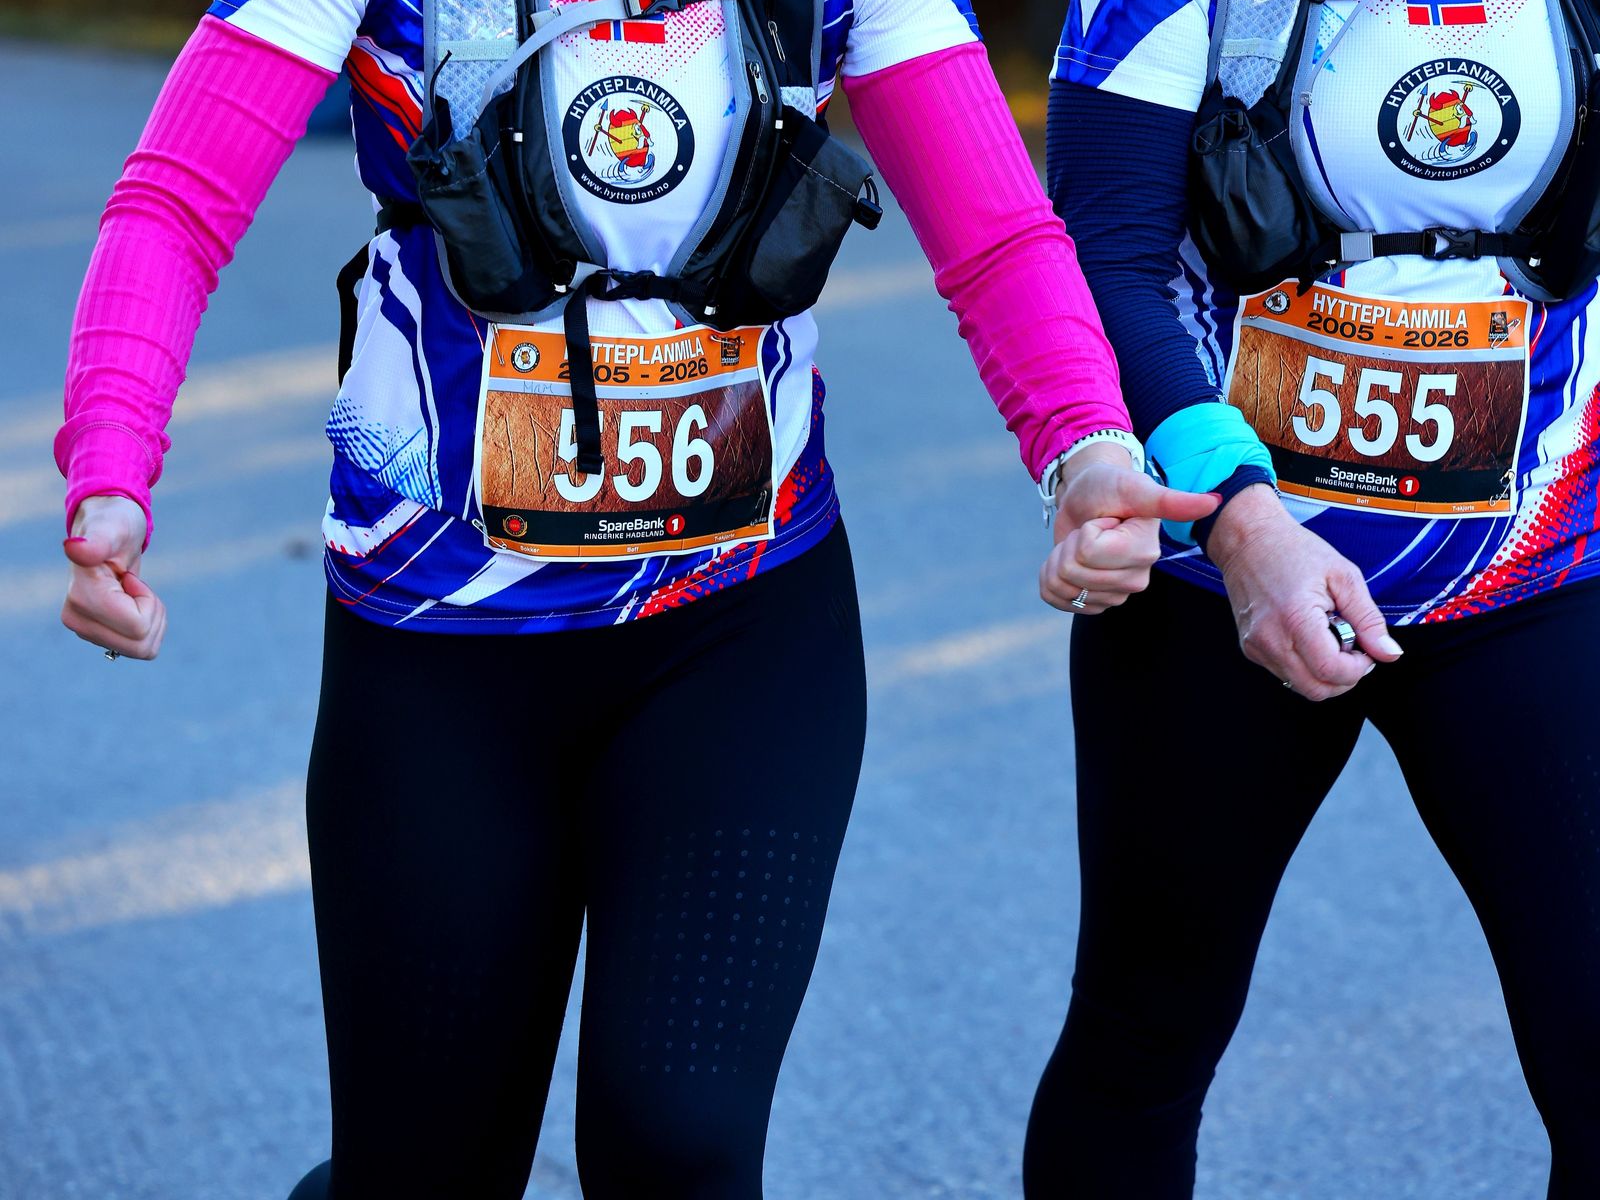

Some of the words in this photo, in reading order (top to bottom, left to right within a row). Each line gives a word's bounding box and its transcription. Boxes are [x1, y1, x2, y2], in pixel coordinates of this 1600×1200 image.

[1386, 60, 1513, 108] HYTTEPLANMILA
[569, 78, 688, 131] HYTTEPLANMILA
[1400, 156, 1493, 179] www.hytteplan.no
[580, 172, 670, 202] www.hytteplan.no
[1312, 291, 1469, 329] HYTTEPLANMILA
[1306, 311, 1375, 342] 2005
[1402, 329, 1470, 348] 2026
[563, 336, 706, 365] TTEPLANMILA
[557, 362, 631, 384] 205
[658, 357, 709, 383] 2026
[1291, 355, 1458, 463] 555
[1315, 476, 1355, 489] RINGERIKE
[1356, 483, 1397, 494] HADELAND
[1329, 466, 1398, 487] SpareBank
[584, 532, 624, 540] RINGERIKE
[625, 530, 665, 539] HADELAND
[598, 517, 665, 533] SpareBank
